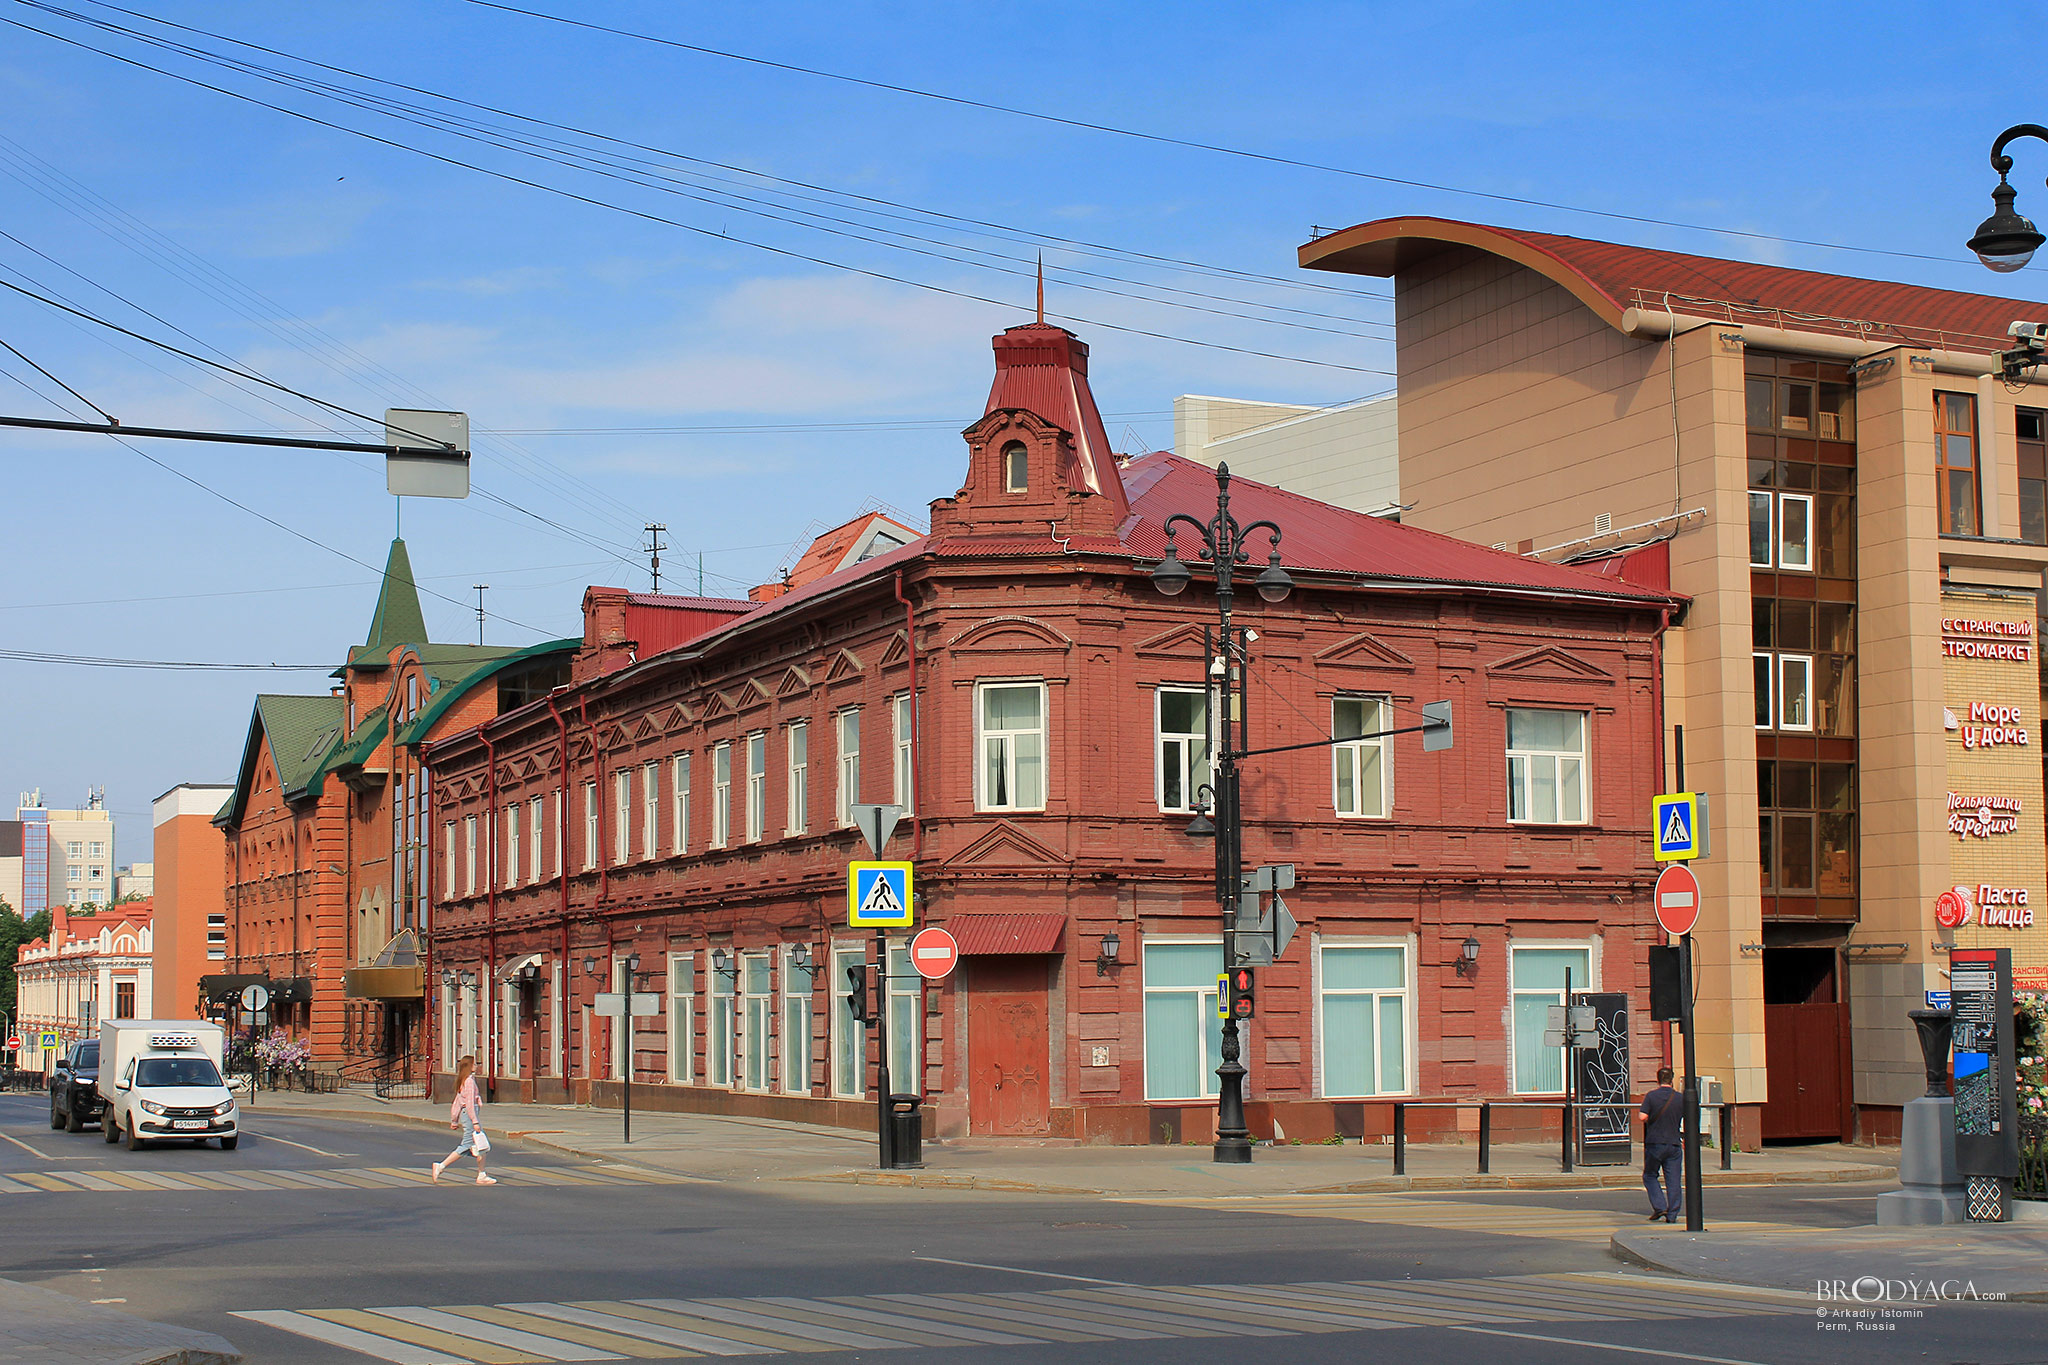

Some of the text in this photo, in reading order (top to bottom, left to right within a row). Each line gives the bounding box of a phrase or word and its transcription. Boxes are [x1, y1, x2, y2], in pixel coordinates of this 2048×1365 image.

[1953, 617, 2033, 635] СТРАНСТВИЙ
[1970, 702, 2021, 727] Море
[1980, 727, 2029, 747] дома
[1946, 791, 2022, 812] Пельмешки
[1978, 884, 2029, 904] Паста
[1980, 904, 2034, 928] Пицца
[1236, 999, 1251, 1012] 29
